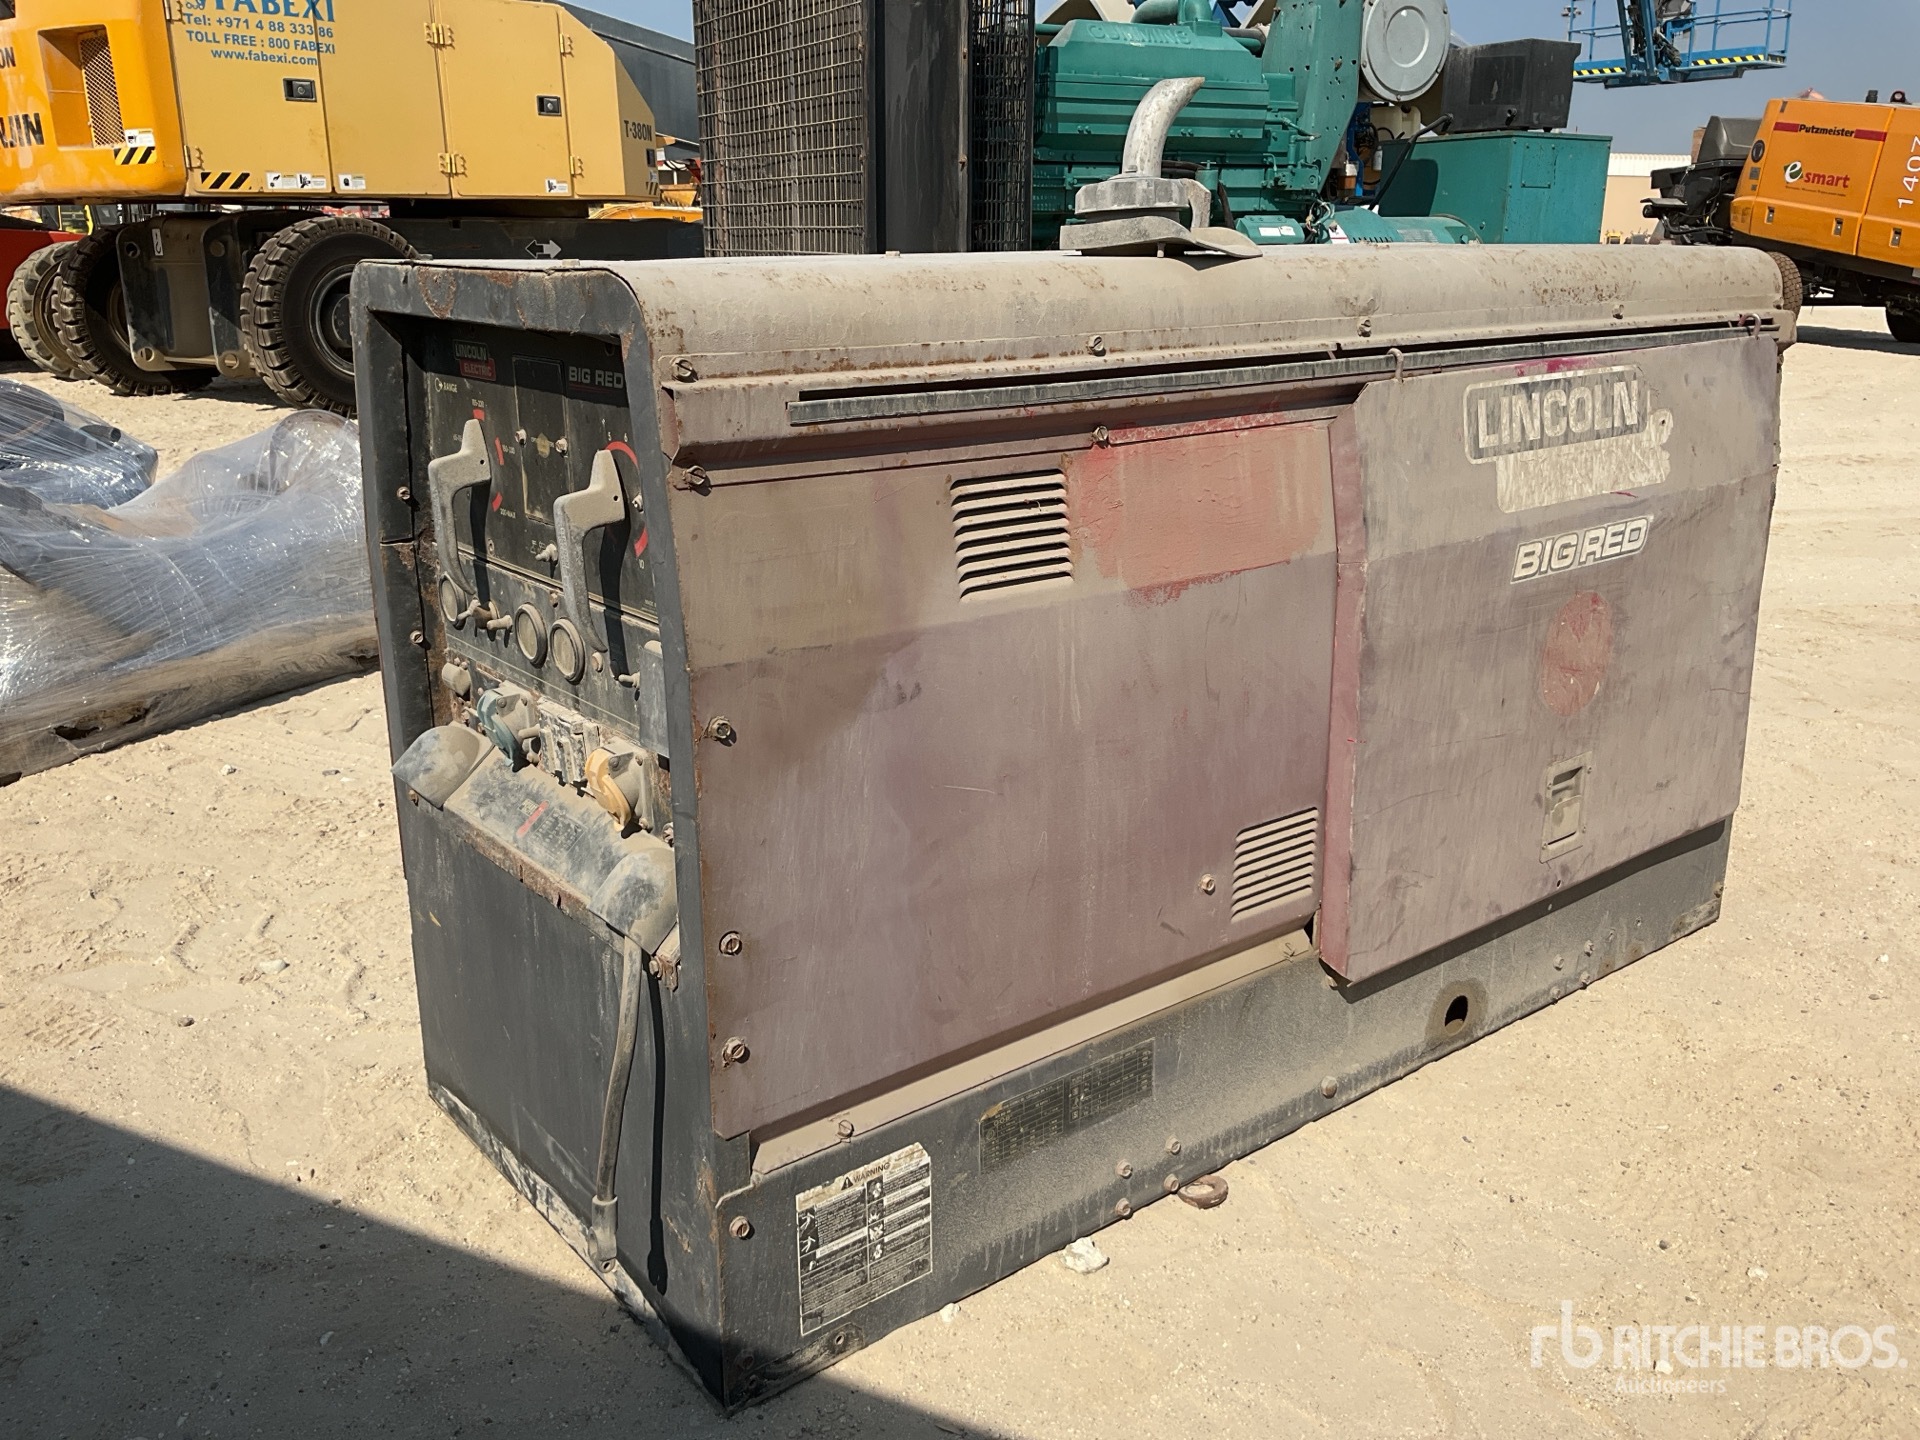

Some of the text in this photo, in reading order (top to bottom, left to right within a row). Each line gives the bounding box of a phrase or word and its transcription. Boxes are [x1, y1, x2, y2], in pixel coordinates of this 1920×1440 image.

[183, 13, 334, 38] Tel: +971 4 88 333 86
[186, 30, 220, 44] TOLL
[224, 33, 257, 47] FREE
[268, 38, 290, 49] 800
[294, 40, 335, 54] FABEXI
[211, 49, 317, 66] www.fabexi.com
[623, 119, 653, 142] T-380N
[1798, 124, 1855, 138] Putzmeister
[1804, 171, 1850, 189] smart
[454, 344, 488, 361] LINCOLN
[463, 363, 493, 378] ELECTRIC
[569, 366, 624, 389] BIG RED
[1478, 380, 1639, 449] LINCOLN
[1512, 517, 1649, 579] BIG RED
[852, 1161, 892, 1184] WARNING
